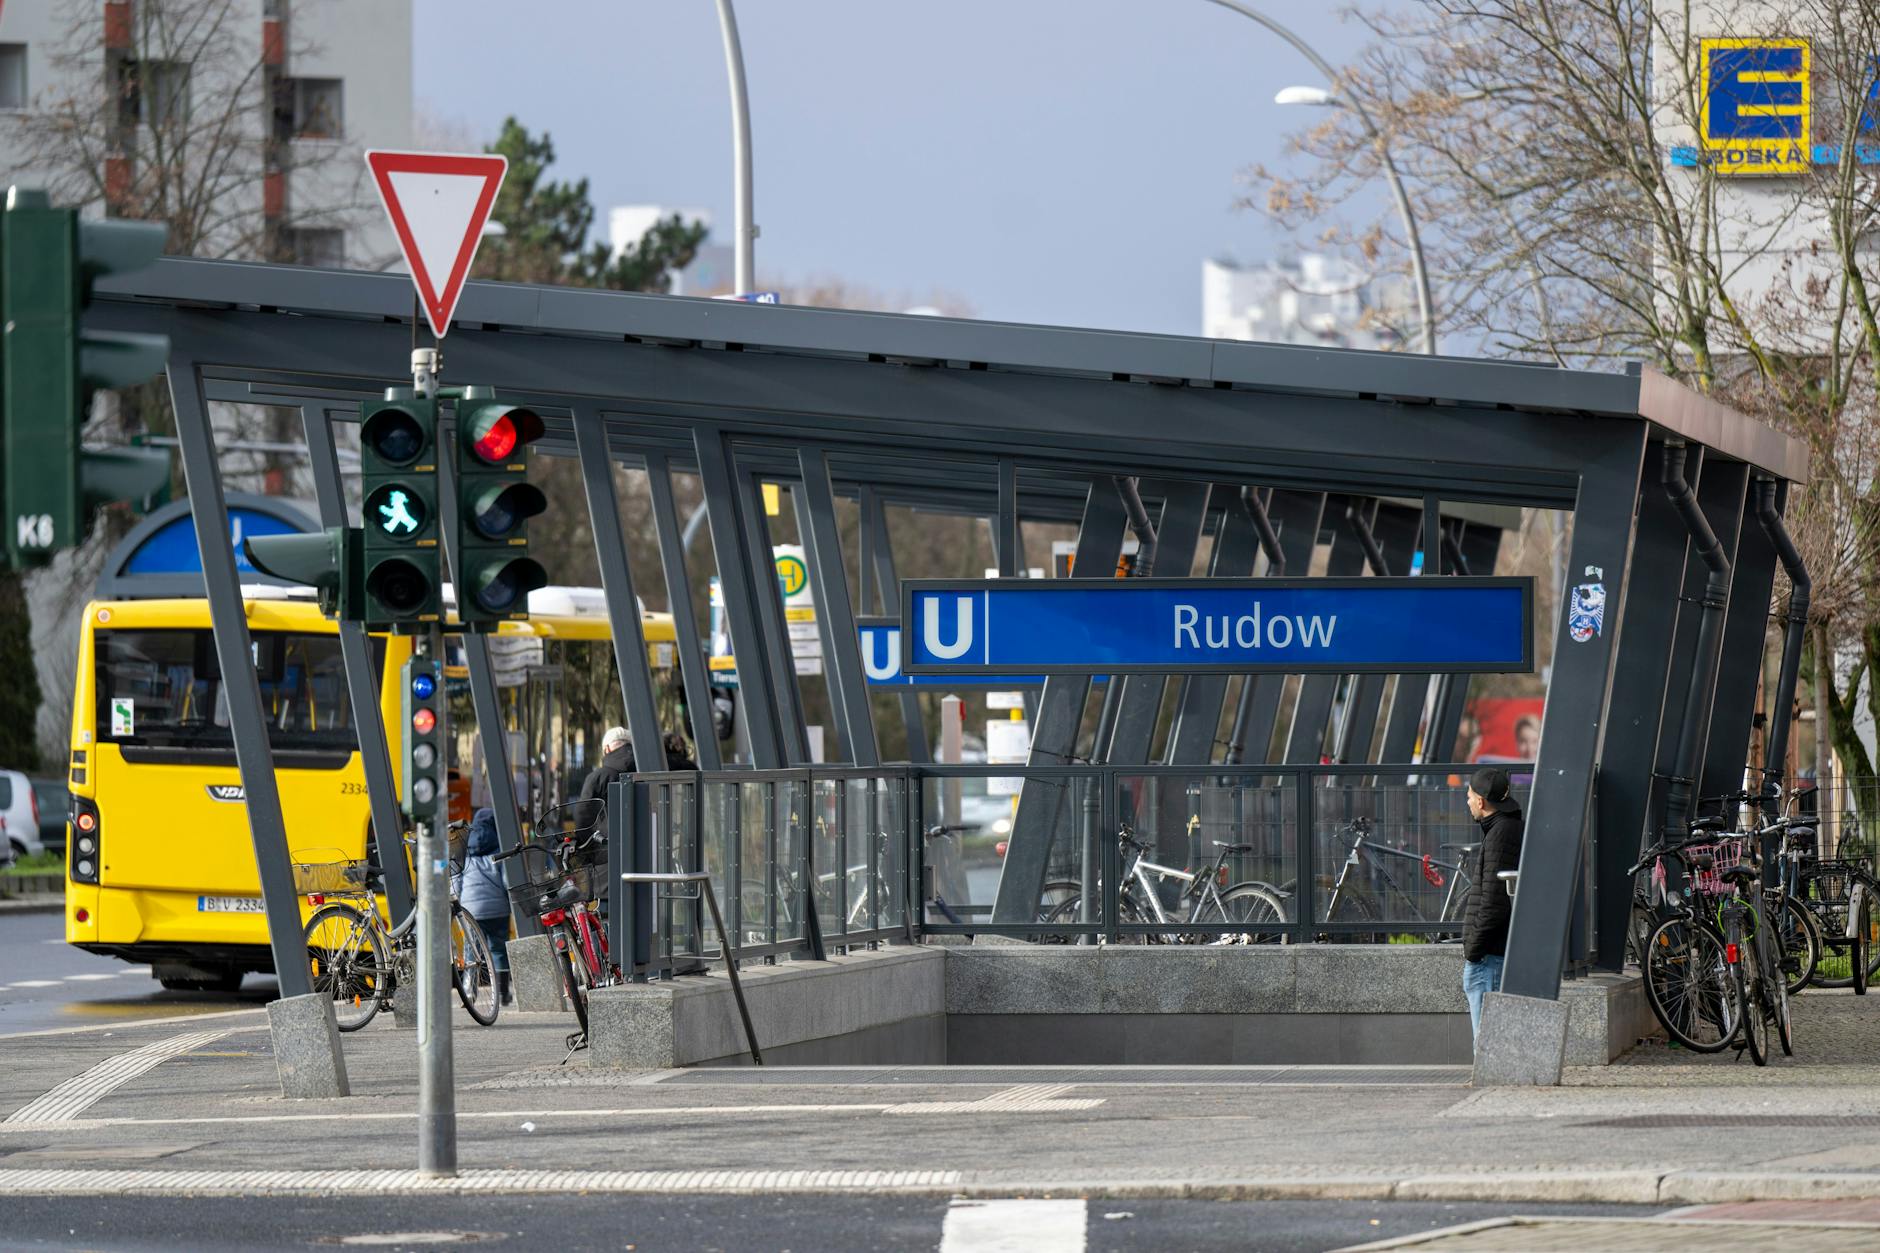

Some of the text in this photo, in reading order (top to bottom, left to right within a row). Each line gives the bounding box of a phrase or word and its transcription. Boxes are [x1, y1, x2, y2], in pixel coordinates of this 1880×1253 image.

[861, 631, 900, 680] U
[924, 597, 1337, 659] U Rudow
